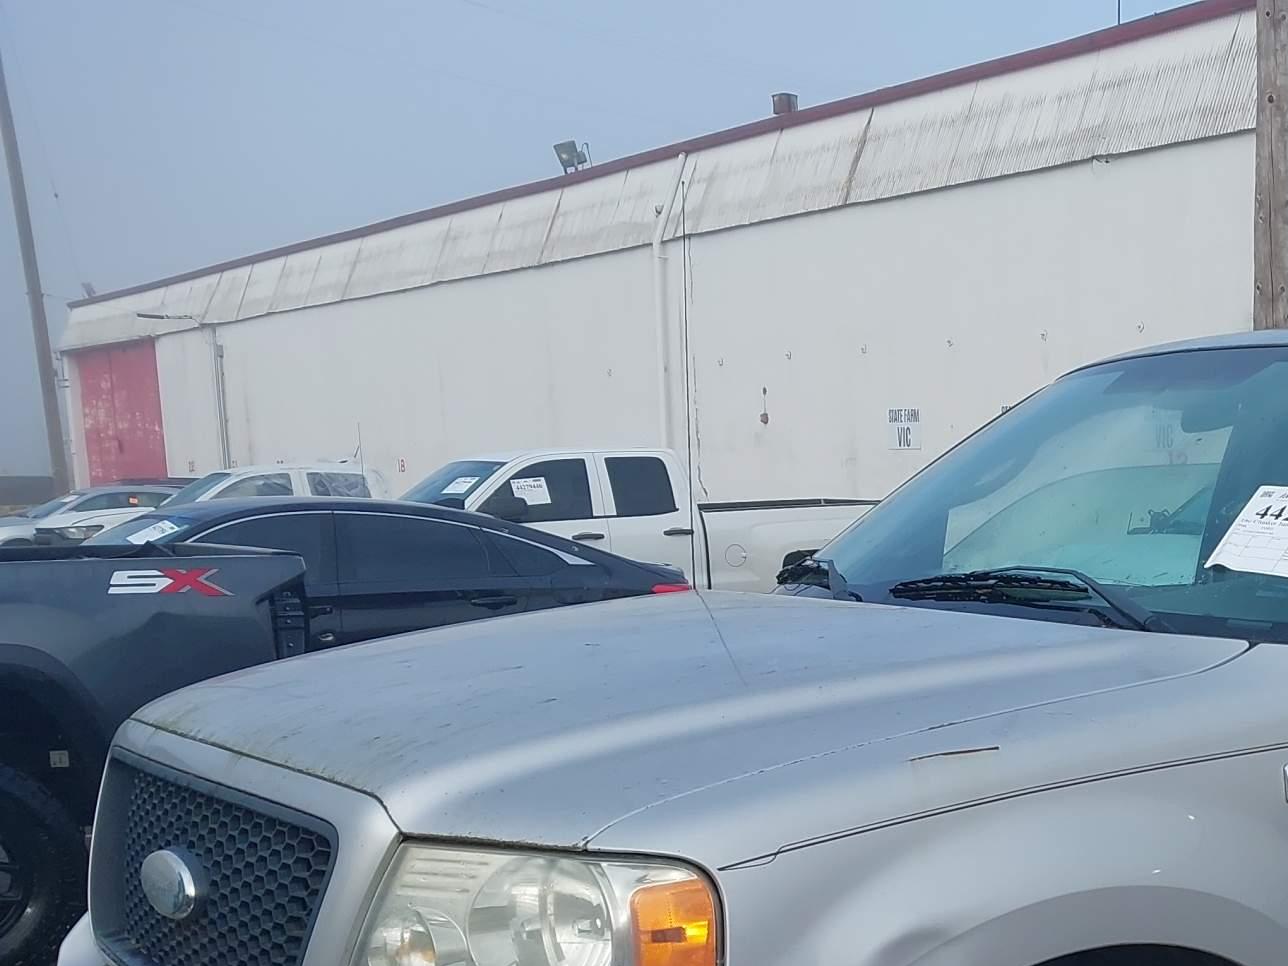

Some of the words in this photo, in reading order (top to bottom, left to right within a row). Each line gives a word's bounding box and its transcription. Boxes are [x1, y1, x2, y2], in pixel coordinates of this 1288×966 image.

[888, 408, 903, 423] STATE
[904, 408, 920, 423] FARM
[897, 426, 911, 447] VIC
[107, 568, 236, 596] SX
